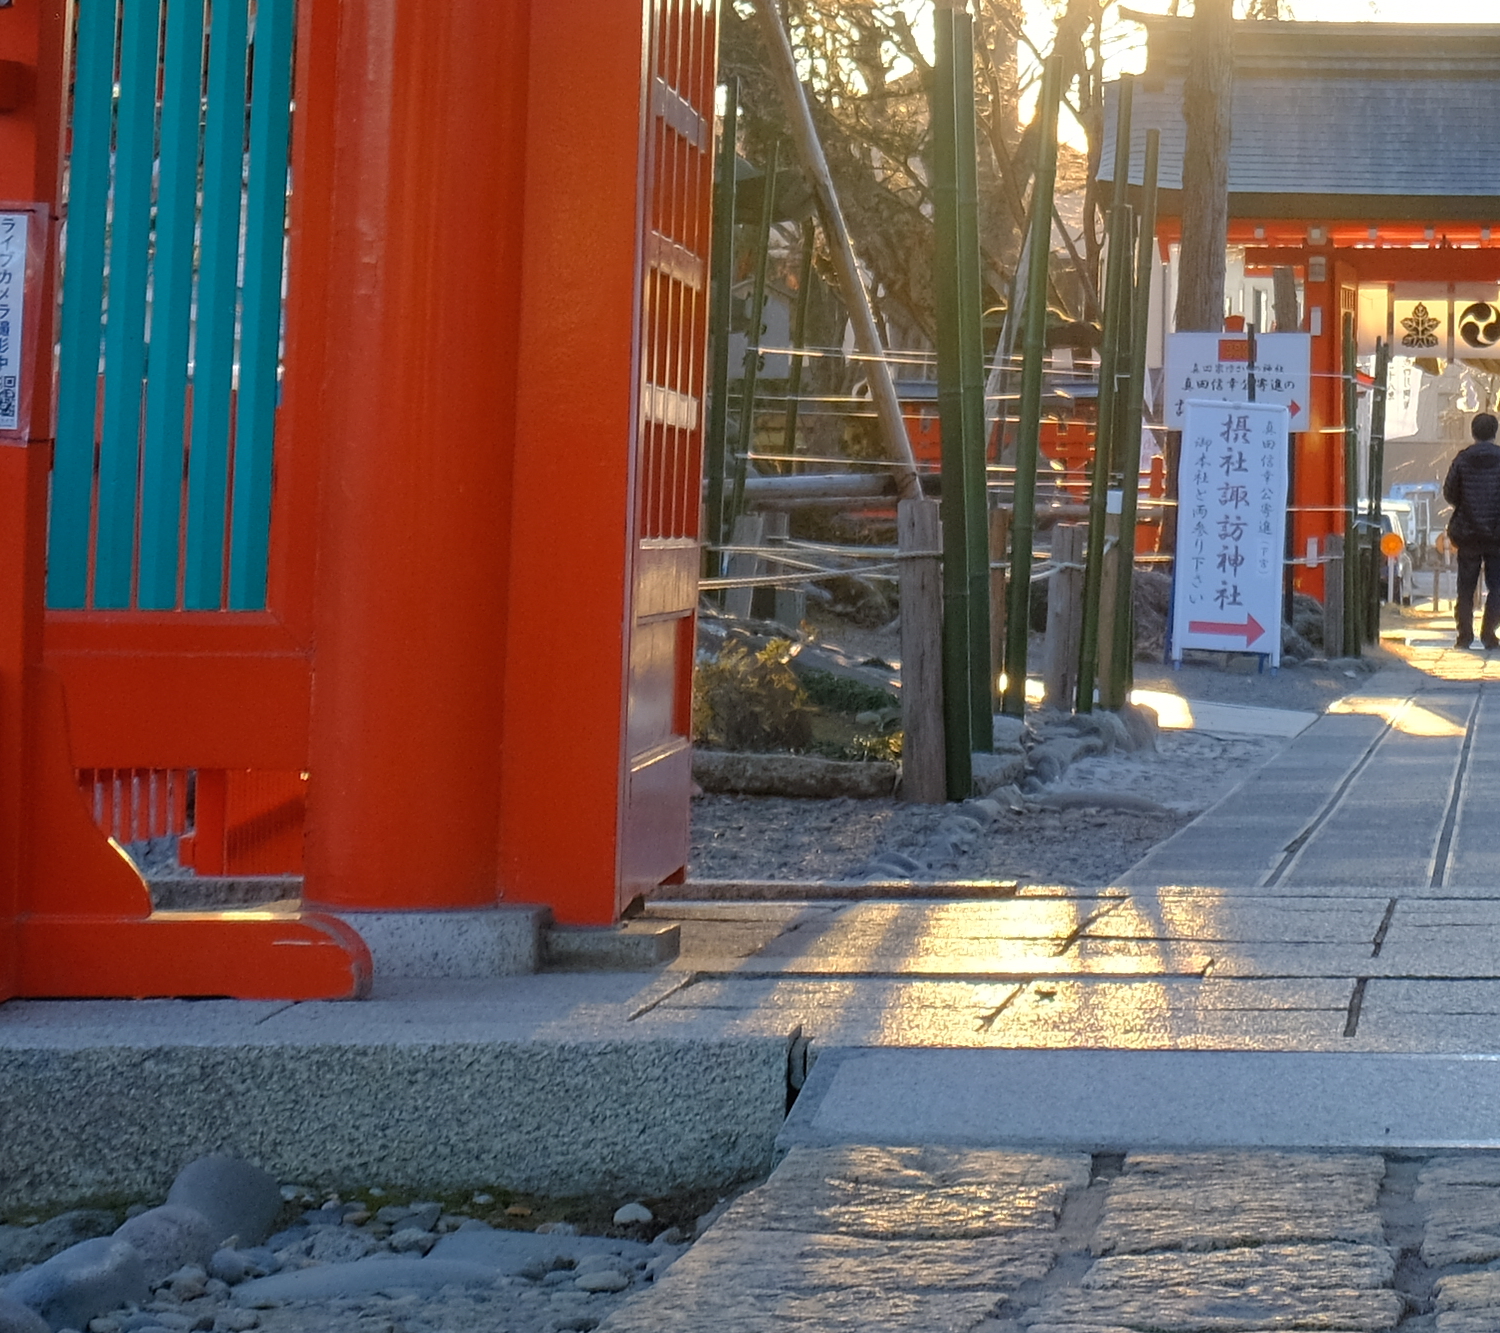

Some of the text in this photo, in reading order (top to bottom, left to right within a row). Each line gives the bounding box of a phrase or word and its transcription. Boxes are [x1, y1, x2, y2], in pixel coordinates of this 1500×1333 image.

[1212, 413, 1252, 611] 摂社諏訪神社
